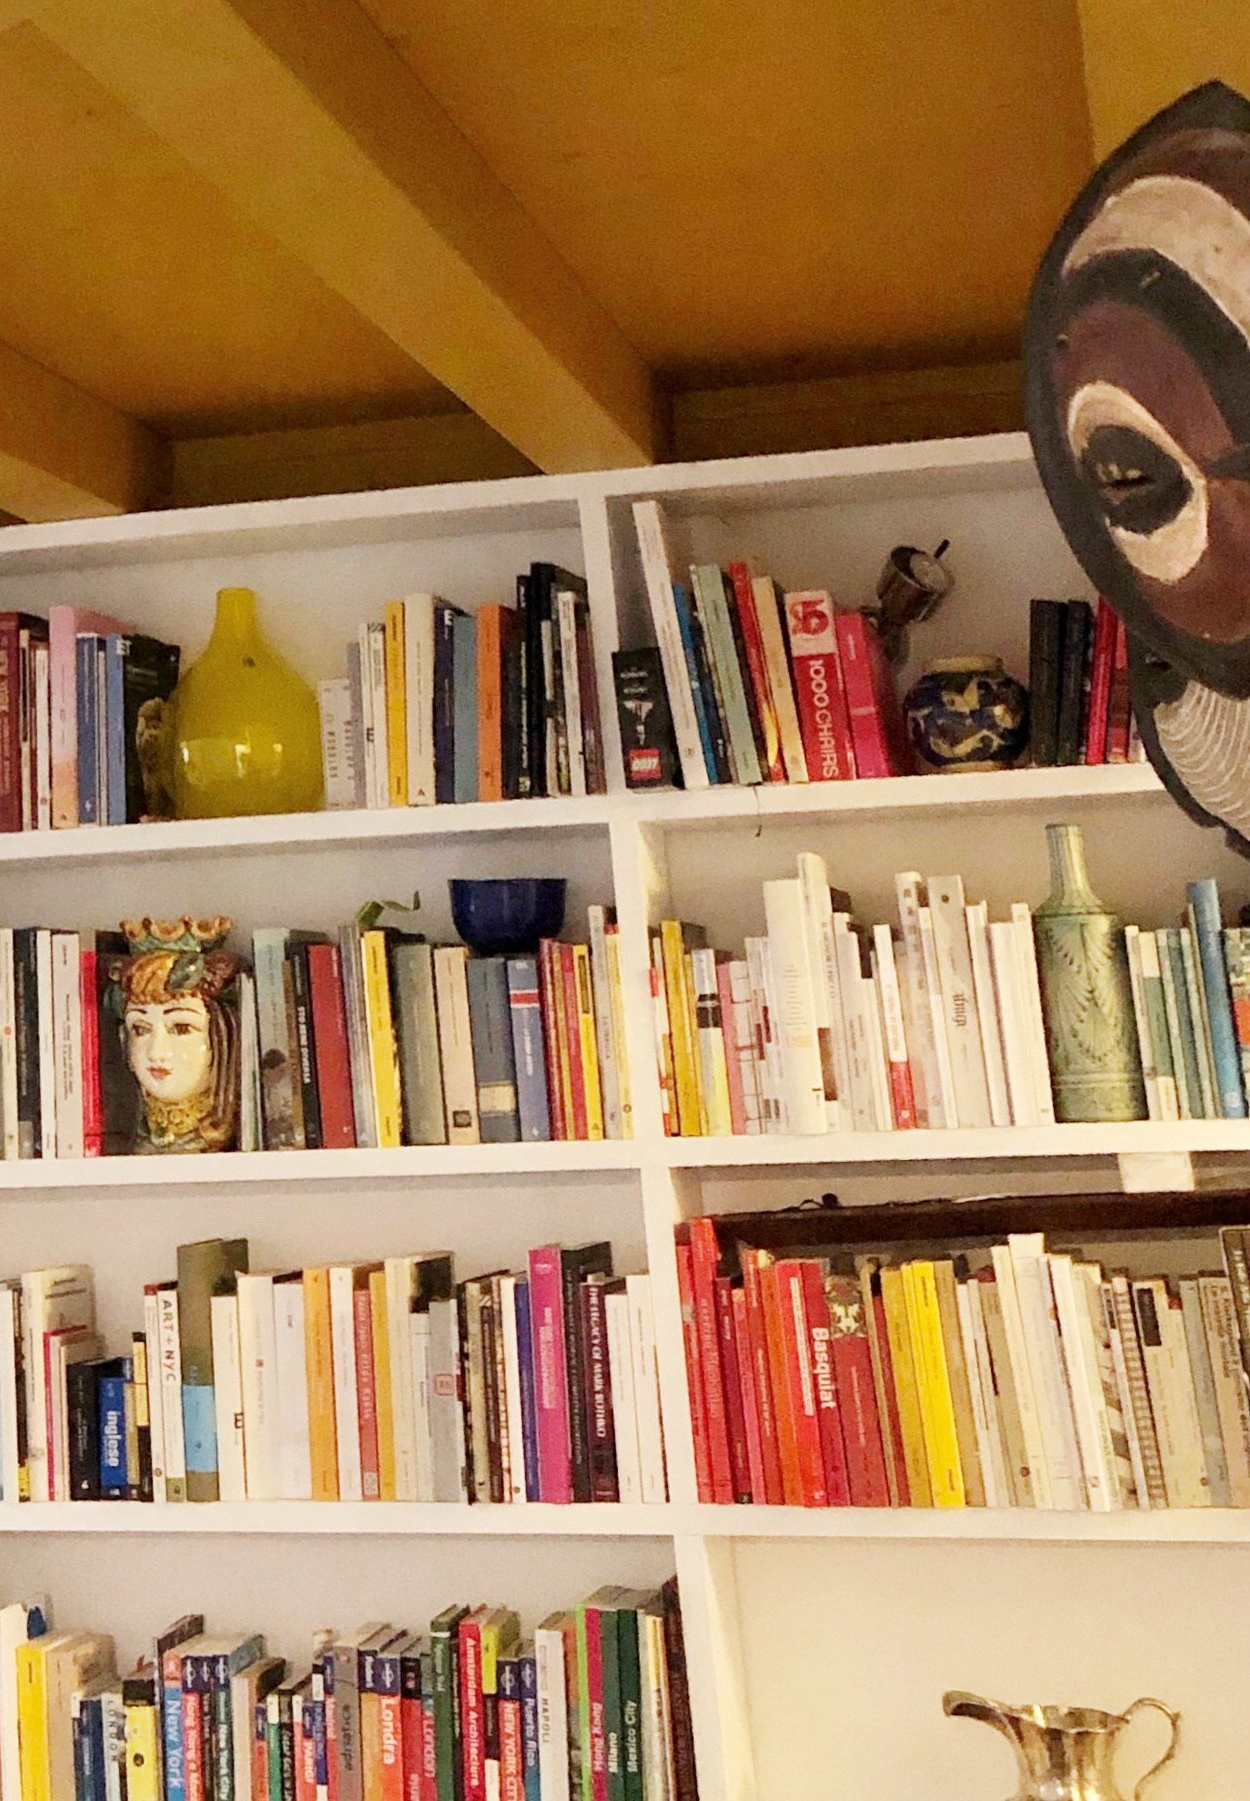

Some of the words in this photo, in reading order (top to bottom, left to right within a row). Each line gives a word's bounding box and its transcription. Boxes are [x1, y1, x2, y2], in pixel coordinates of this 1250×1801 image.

[807, 659, 830, 708] 1000
[815, 709, 839, 778] CHAIRS
[162, 1299, 175, 1332] ART
[589, 1287, 598, 1306] THE
[590, 1306, 600, 1345] LEGACY
[162, 1349, 176, 1383] NYC
[593, 1363, 603, 1391] MARK
[811, 1327, 836, 1409] Basquiat
[595, 1393, 606, 1437] ROTHKO
[104, 1410, 122, 1467] inglese
[466, 1637, 477, 1708] Amsterdam
[107, 1699, 118, 1763] LONDON
[167, 1700, 181, 1742] New
[185, 1695, 195, 1728] Hong
[381, 1697, 397, 1765] Londra
[504, 1701, 516, 1734] NEW
[524, 1697, 535, 1738] Puerto
[541, 1697, 550, 1744] NAPOLI
[592, 1701, 603, 1735] Kong
[623, 1699, 638, 1726] City
[186, 1730, 197, 1760] Kong
[218, 1723, 228, 1749] New
[339, 1704, 355, 1771] adriatica
[423, 1719, 436, 1779] London
[468, 1711, 480, 1787] Architecture
[505, 1737, 517, 1775] YORK
[526, 1740, 537, 1767] Rico
[592, 1737, 603, 1772] Hong
[607, 1731, 618, 1774] Milano
[626, 1729, 638, 1773] Mexico
[169, 1747, 183, 1789] York
[219, 1750, 229, 1776] York
[303, 1741, 314, 1784] PARIGI
[219, 1776, 230, 1801] City
